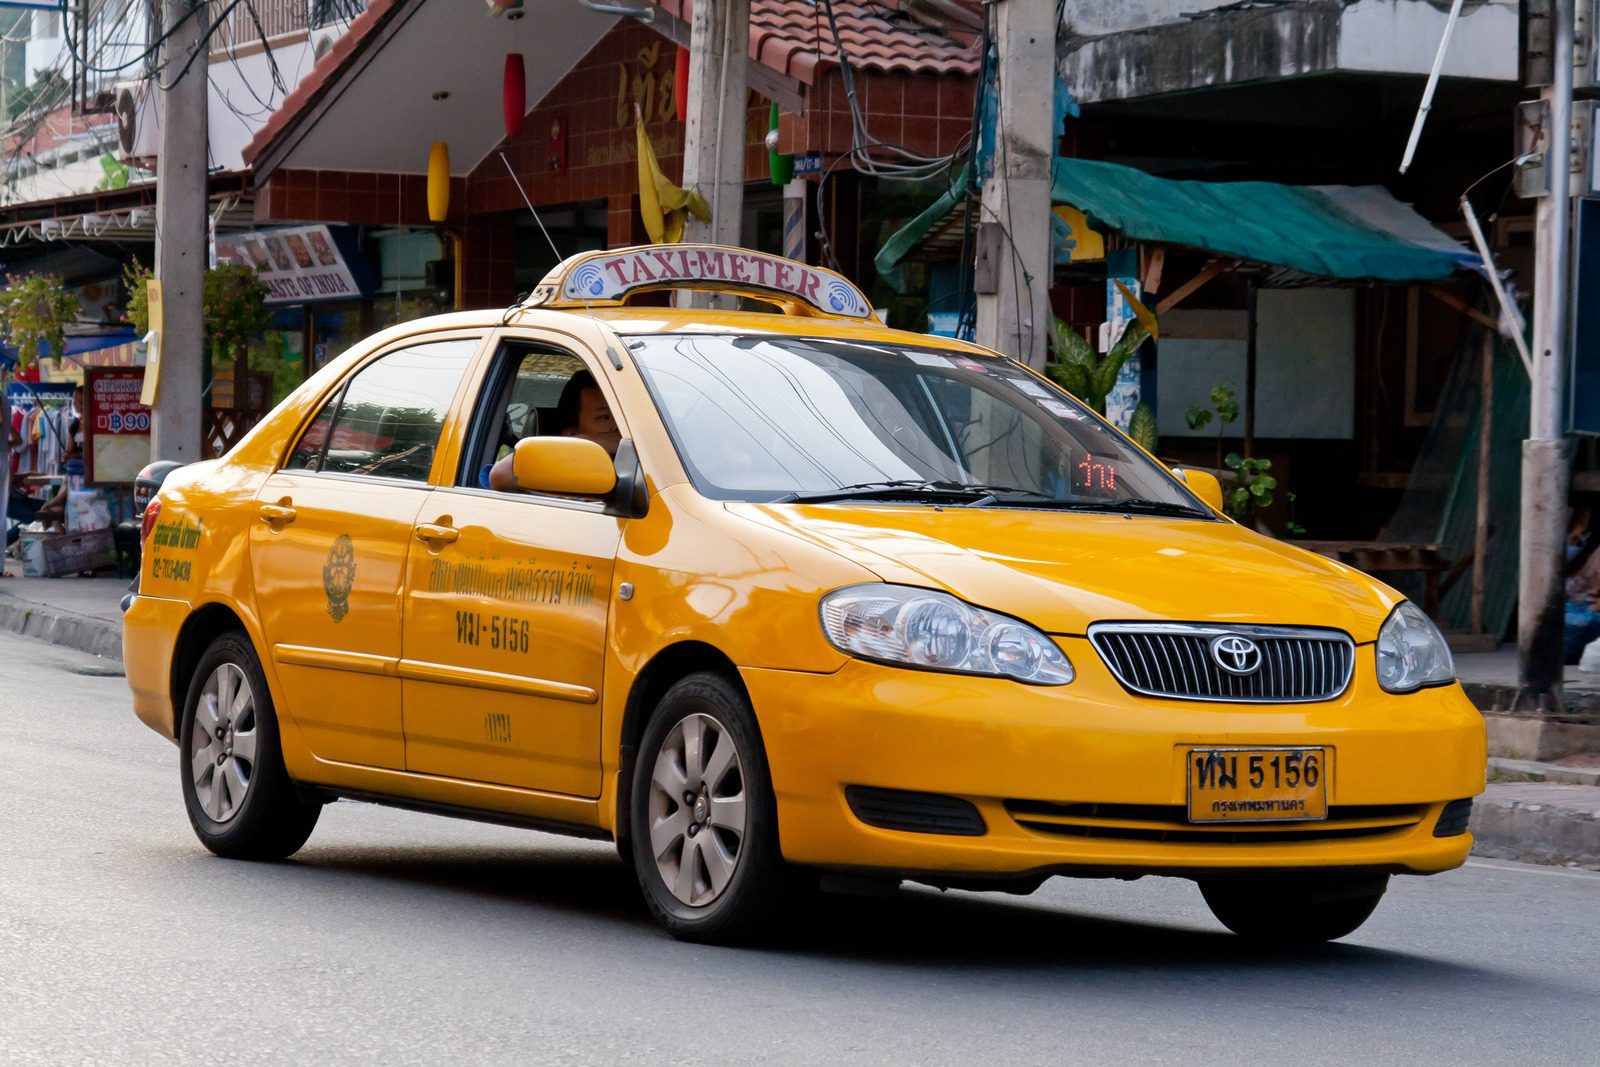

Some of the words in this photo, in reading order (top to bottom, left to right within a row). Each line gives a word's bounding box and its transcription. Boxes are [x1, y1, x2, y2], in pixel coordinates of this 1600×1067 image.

[265, 278, 300, 299] ASTE
[299, 275, 315, 297] OF
[311, 273, 350, 294] INDIA
[605, 249, 821, 301] TAXI-METER
[1079, 453, 1115, 489] ว่าง
[1196, 752, 1237, 789] ทม
[1249, 754, 1319, 789] 5156
[1212, 799, 1305, 817] กรุงเทพมหานคร
